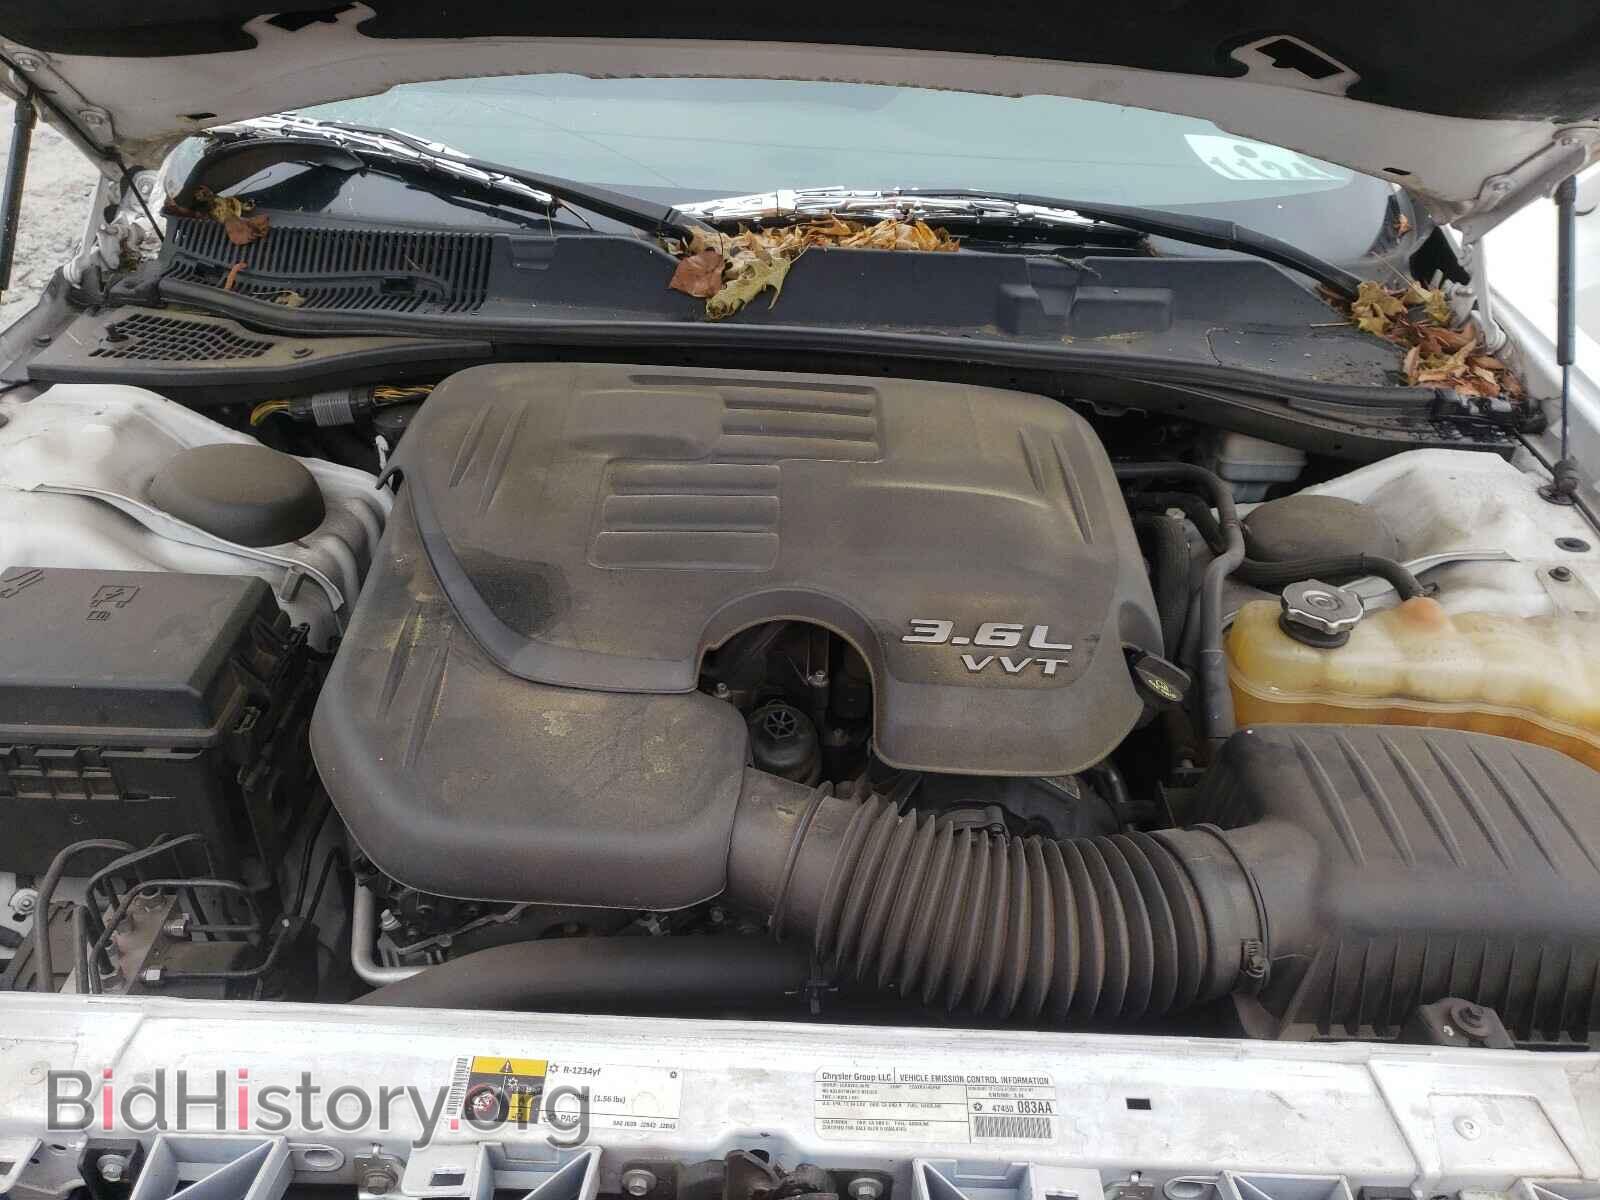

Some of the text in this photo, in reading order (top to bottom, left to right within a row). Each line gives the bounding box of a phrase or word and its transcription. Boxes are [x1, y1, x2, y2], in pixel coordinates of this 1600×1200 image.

[902, 618, 1073, 650] 3.6L
[960, 654, 1069, 675] VVT
[563, 1066, 601, 1077] R-1234yf
[822, 1071, 892, 1083] Chrysler Group LLC
[899, 1073, 1050, 1086] VEHICLE EMISSION CONTROL INFORMATION
[1017, 1100, 1053, 1114] 083AA
[561, 1113, 579, 1123] PAG
